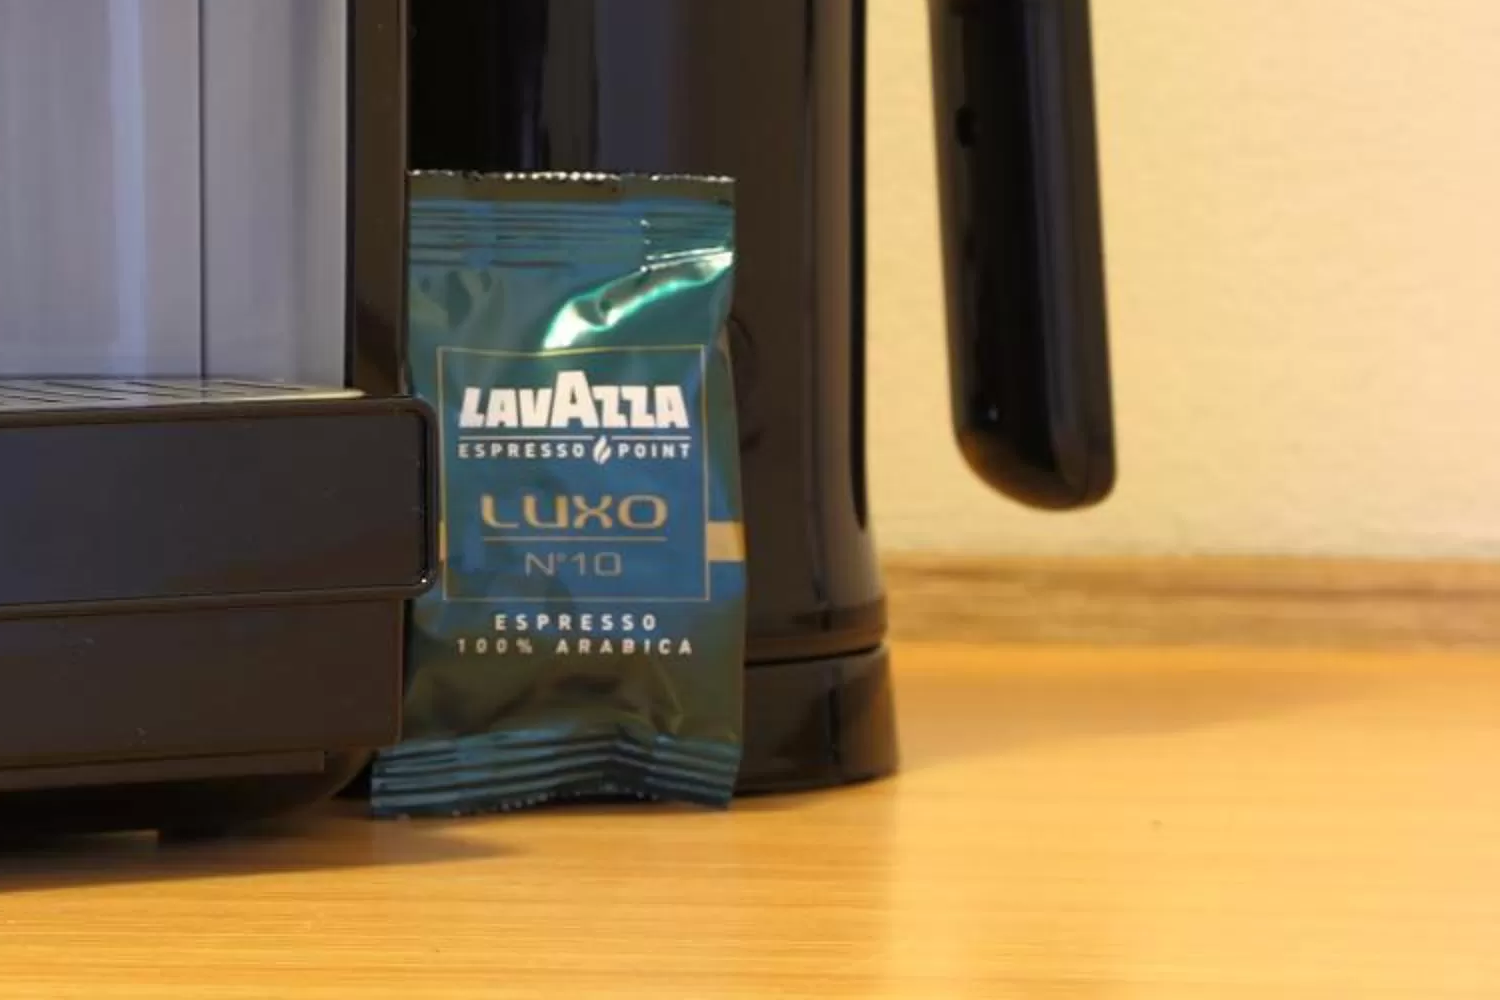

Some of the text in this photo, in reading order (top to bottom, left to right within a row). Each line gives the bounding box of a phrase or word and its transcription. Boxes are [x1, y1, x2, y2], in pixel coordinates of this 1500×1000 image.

[459, 370, 689, 430] LAVAZZA
[458, 441, 691, 459] ESPRESSO POINT
[480, 494, 668, 529] LUXO
[494, 613, 657, 631] ESPRESSO
[457, 637, 693, 656] 100% ARABICA
